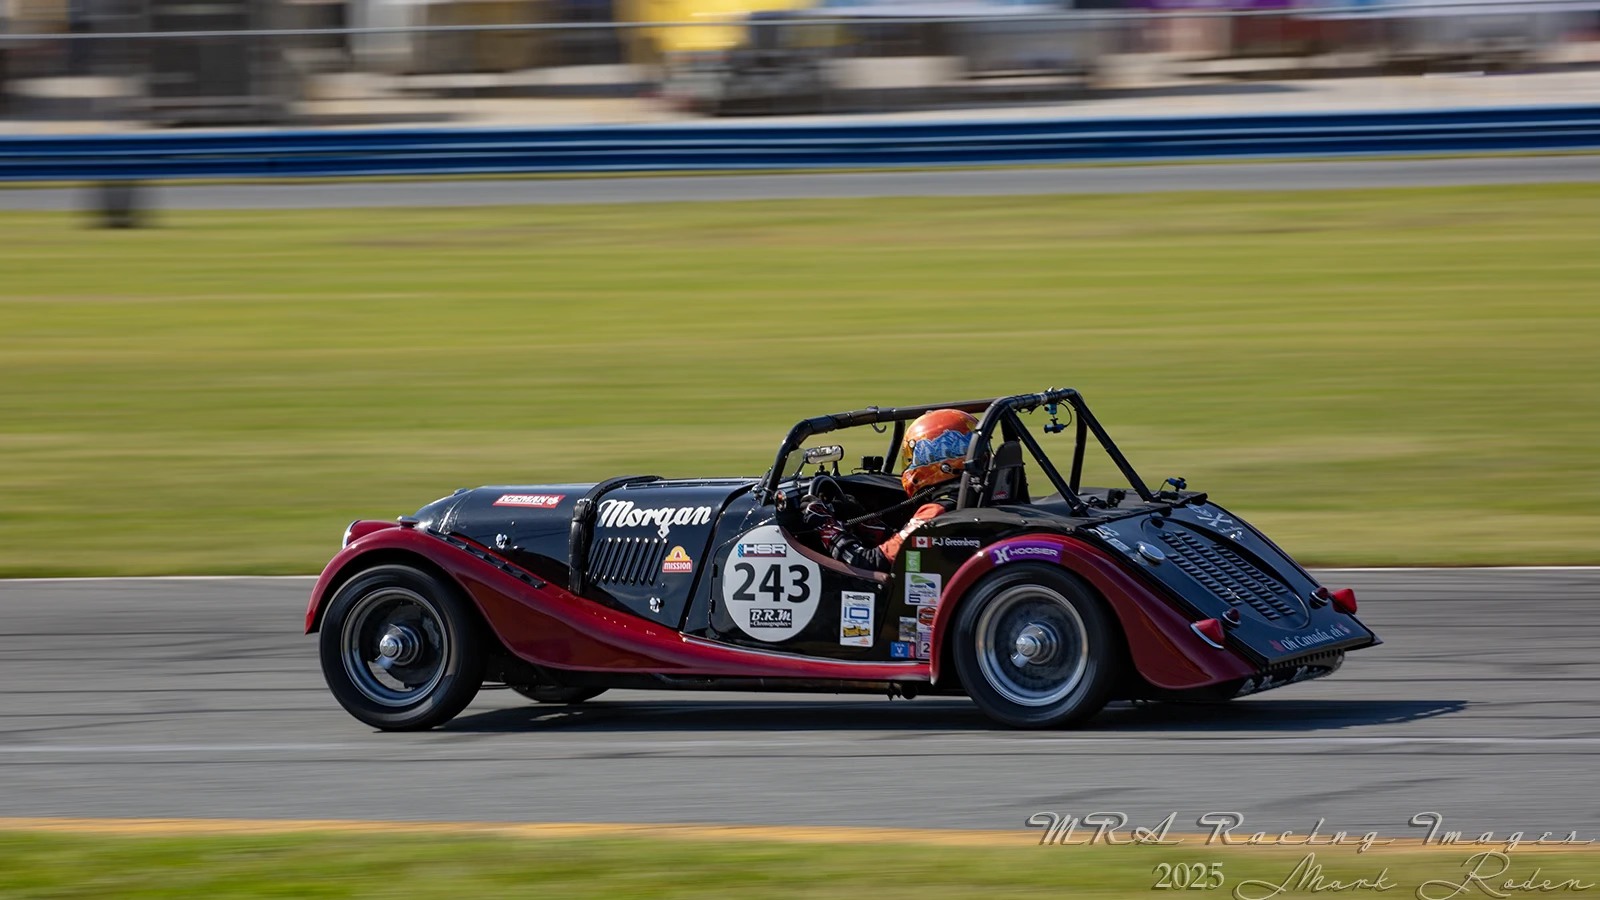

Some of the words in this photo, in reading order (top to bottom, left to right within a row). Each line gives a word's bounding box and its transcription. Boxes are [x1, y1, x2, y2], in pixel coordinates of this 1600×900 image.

[597, 499, 712, 539] Morgan
[743, 544, 786, 554] HSR
[1009, 547, 1059, 557] HOOSIER
[663, 562, 692, 571] MISSION
[732, 562, 810, 604] 243
[844, 606, 870, 619] 10
